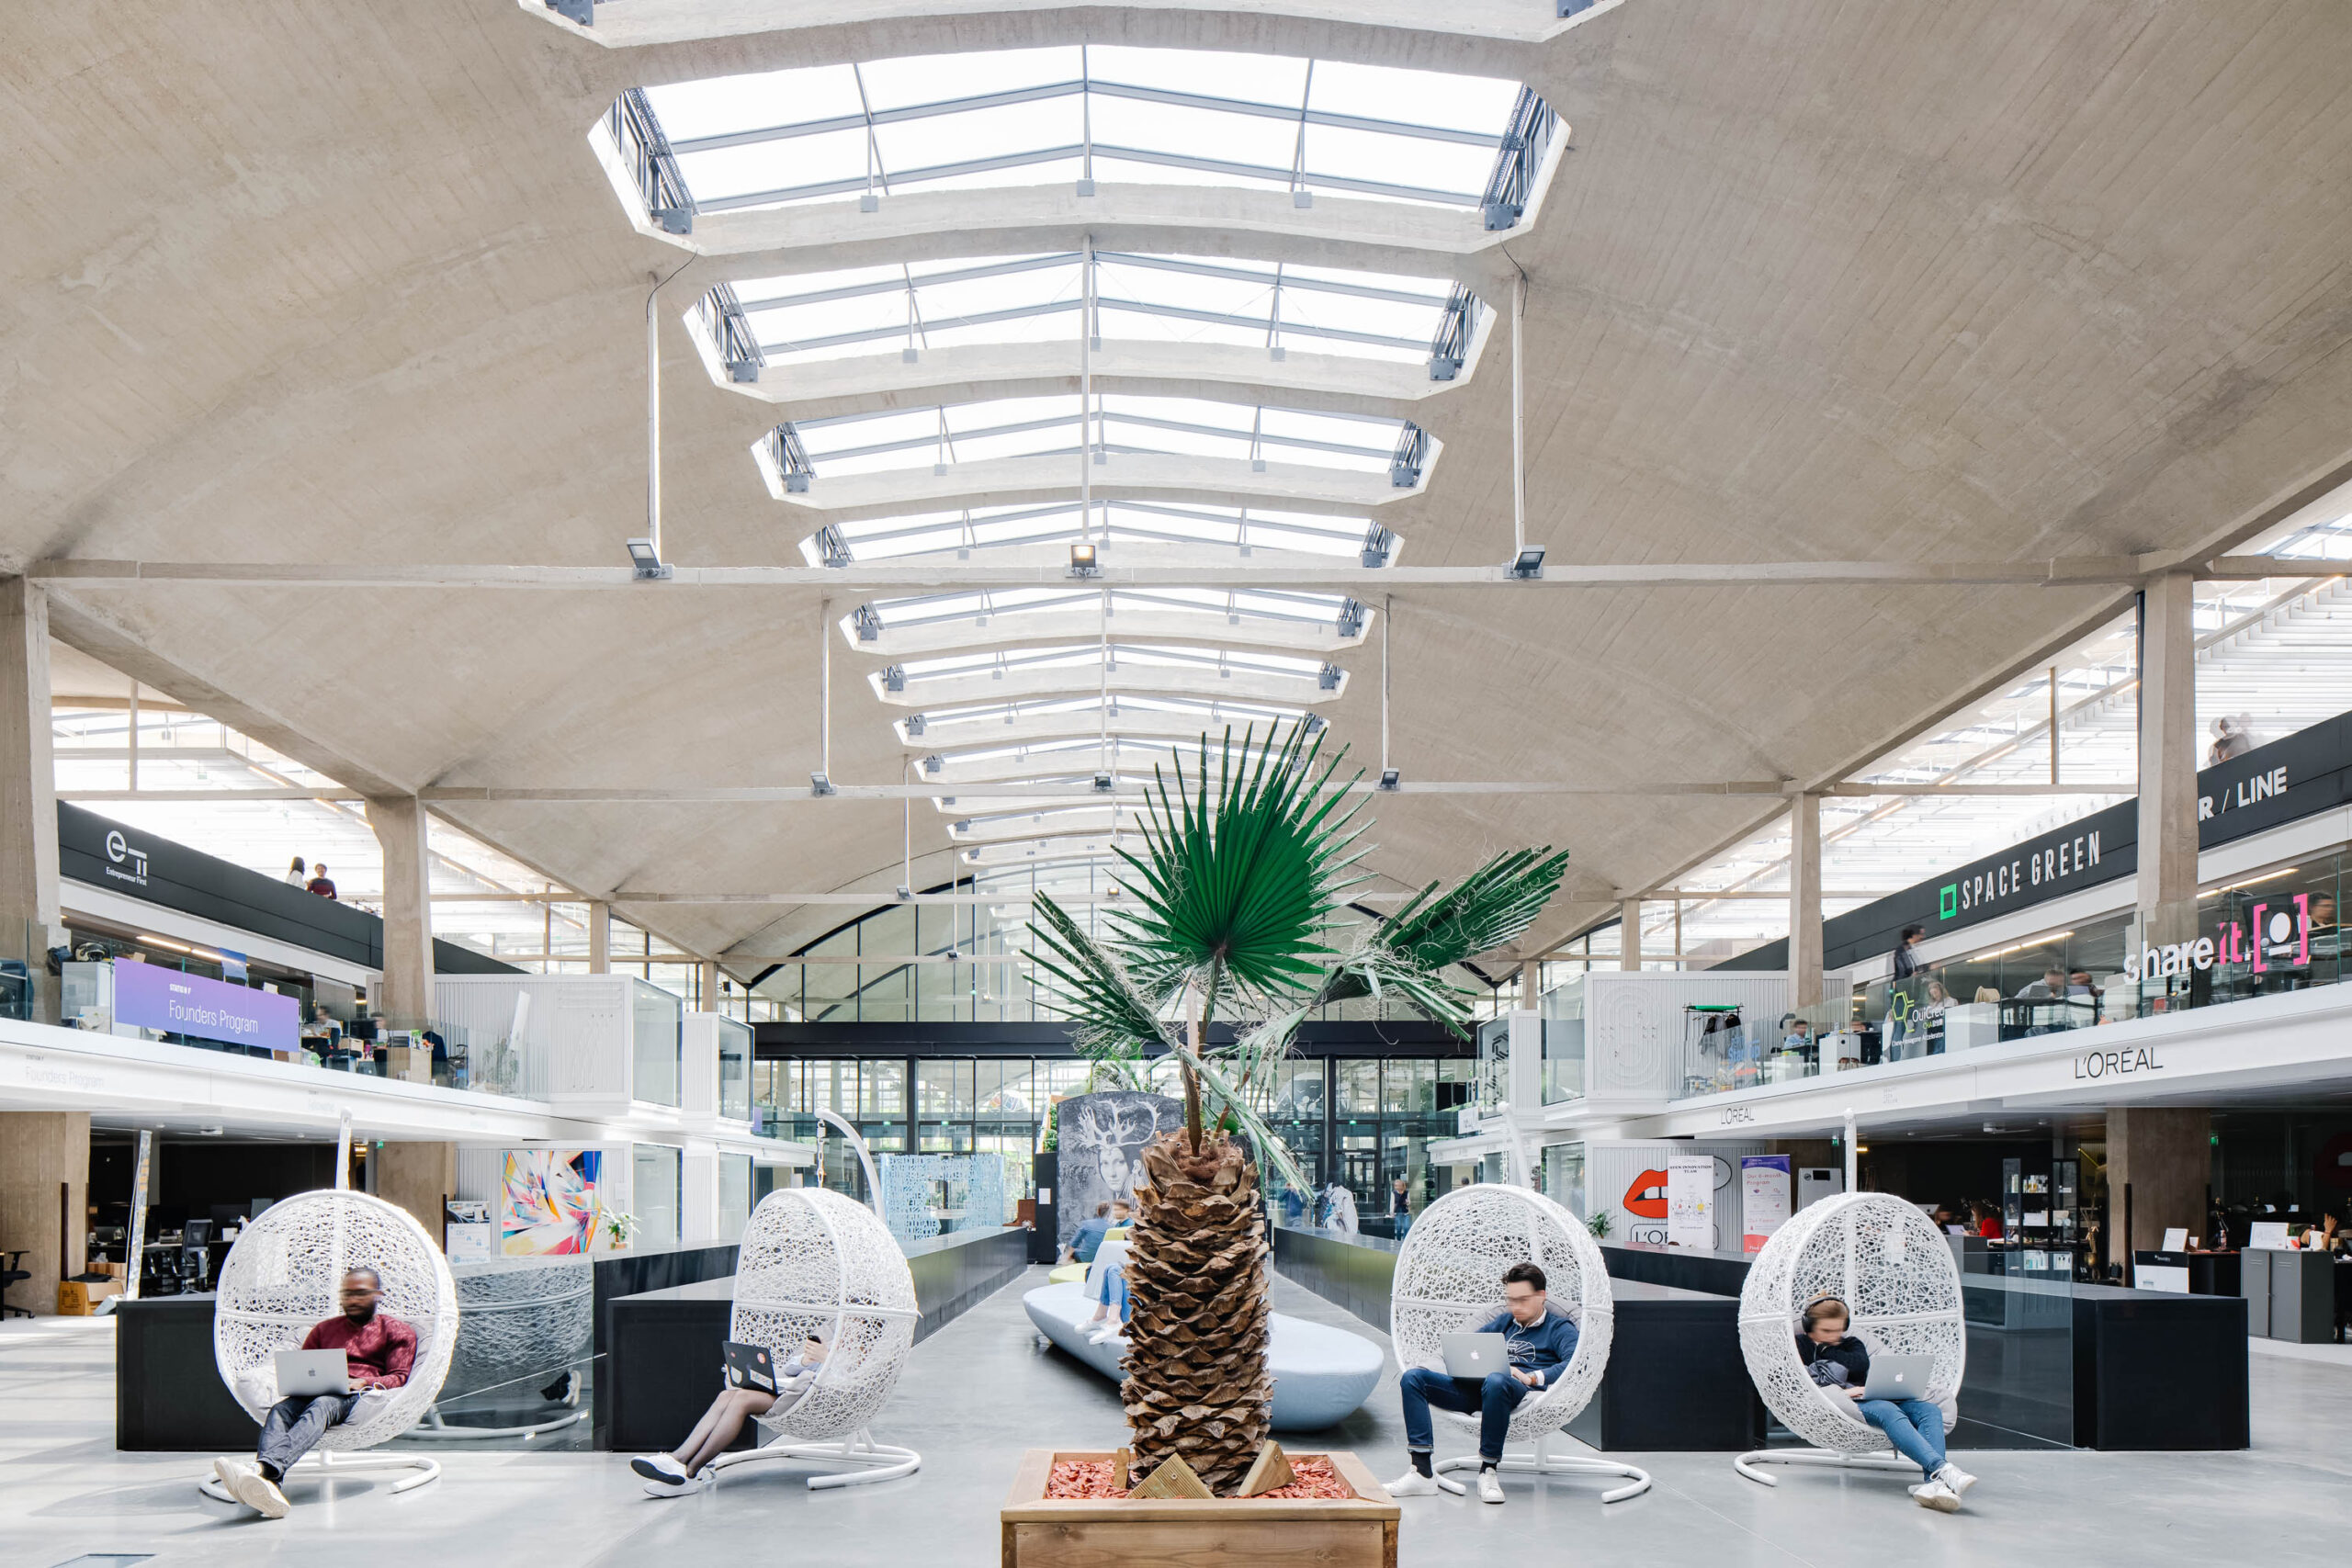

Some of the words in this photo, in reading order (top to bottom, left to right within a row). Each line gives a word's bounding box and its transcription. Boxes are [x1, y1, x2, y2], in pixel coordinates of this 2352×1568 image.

[2237, 765, 2288, 808] LINE
[1962, 860, 2021, 910] SPACE
[2030, 830, 2101, 886] GREEN
[169, 999, 217, 1027] Founders
[220, 1009, 258, 1035] Program
[2075, 1046, 2164, 1078] L'ORÉAL
